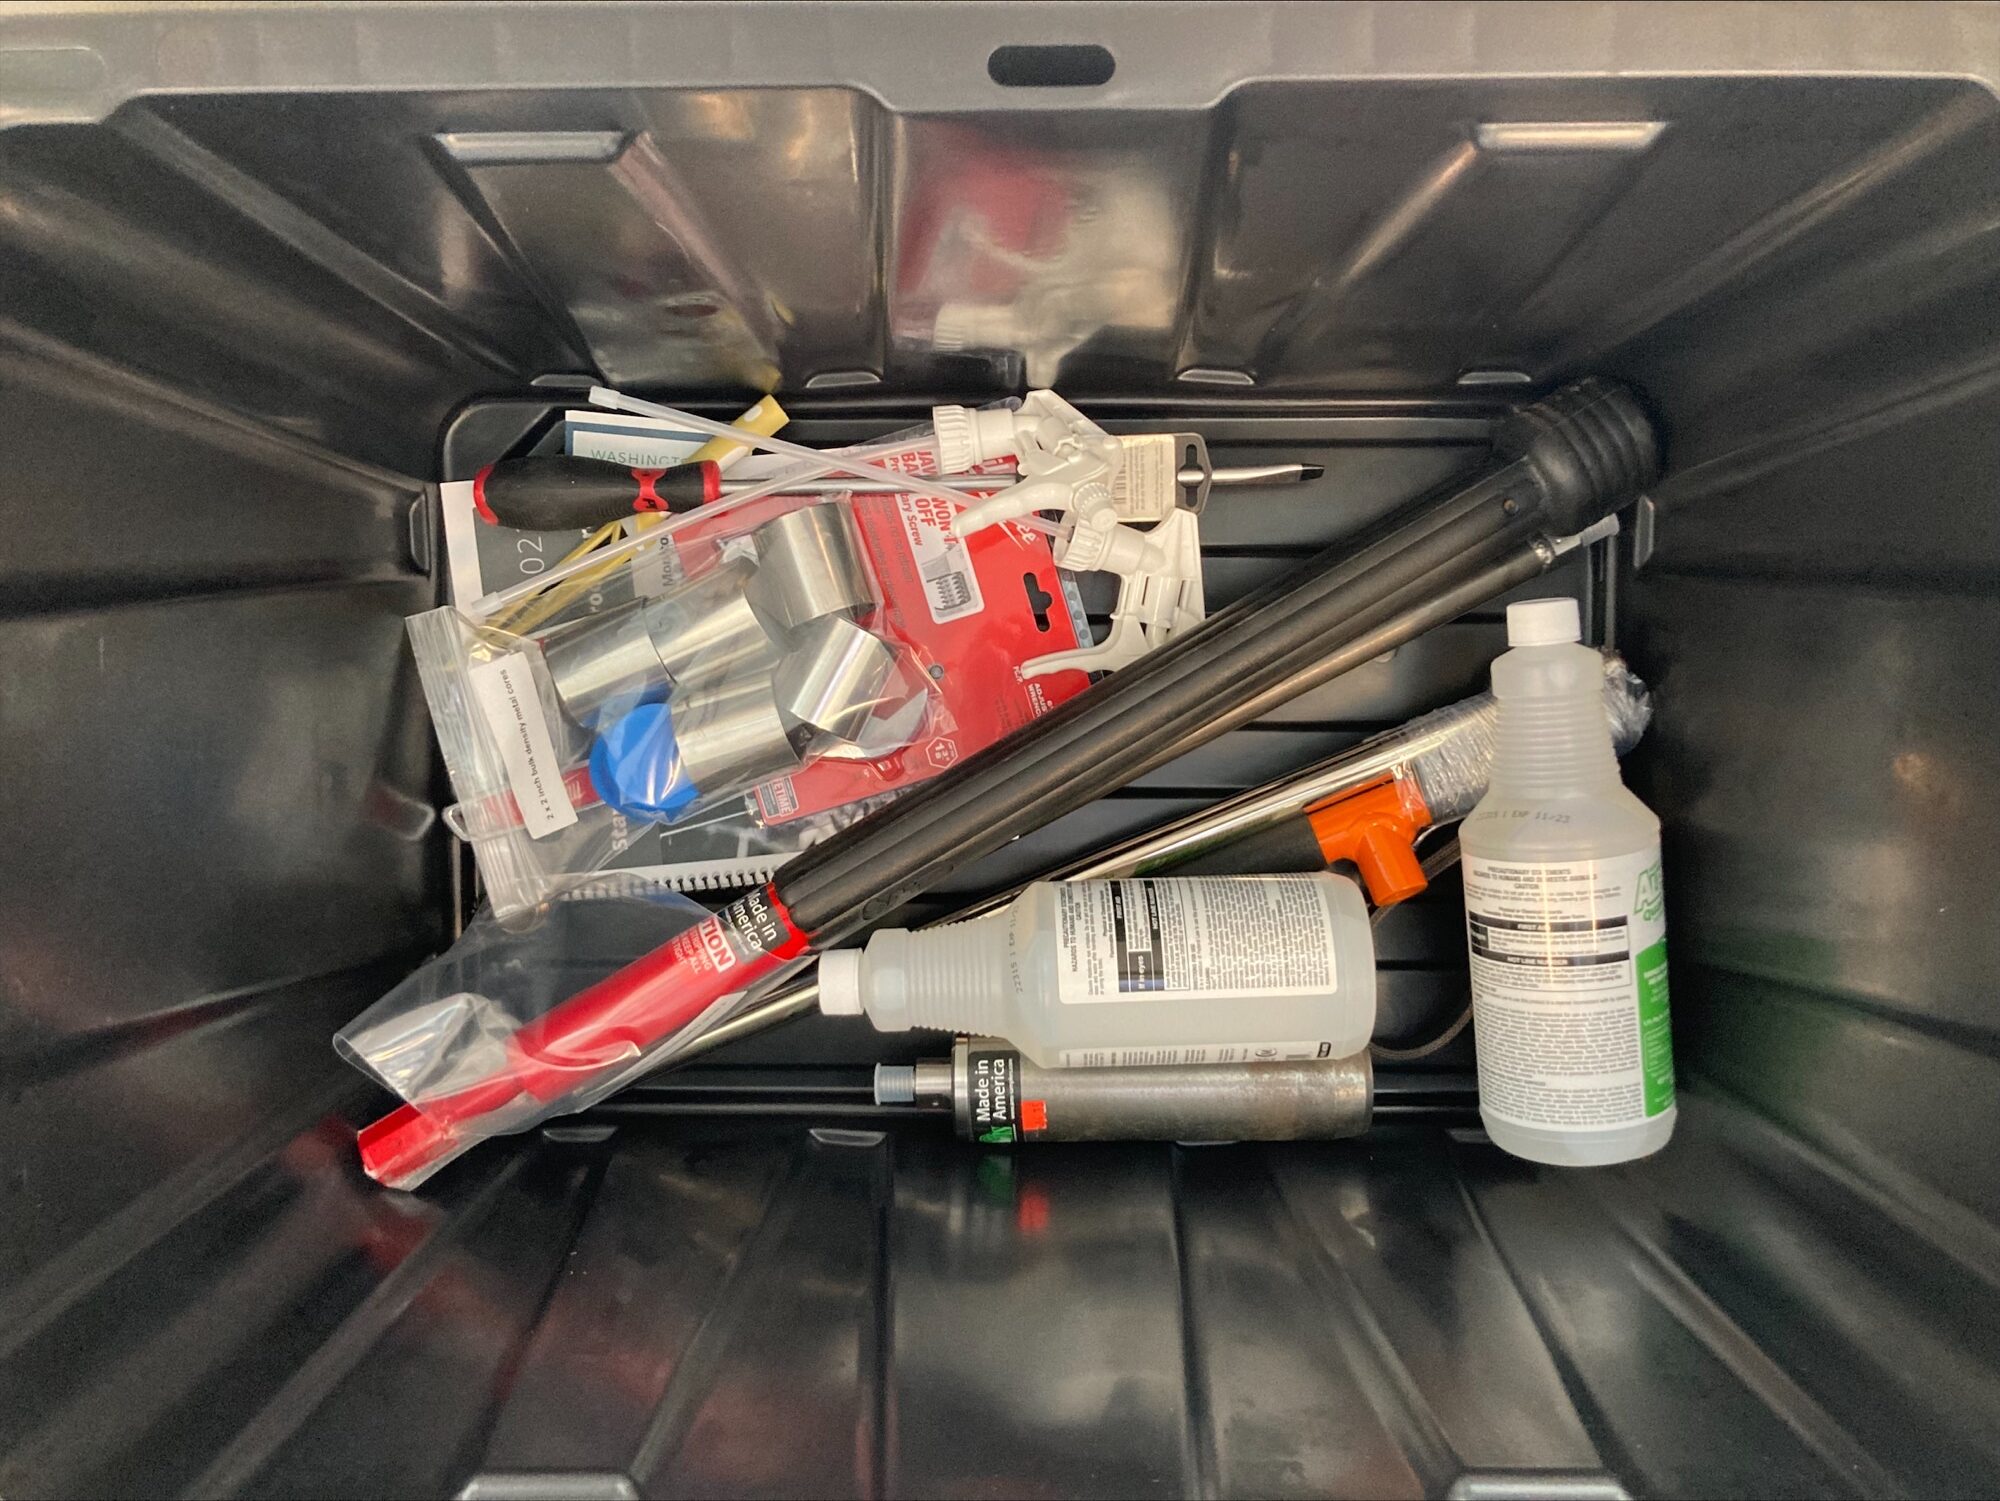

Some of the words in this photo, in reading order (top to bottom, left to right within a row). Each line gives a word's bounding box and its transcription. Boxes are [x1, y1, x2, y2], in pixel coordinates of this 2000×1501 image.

[915, 498, 937, 527] OFF
[907, 514, 923, 547] Screw
[500, 668, 514, 694] cores
[508, 697, 523, 721] metal
[1034, 683, 1048, 712] ADJUS
[518, 722, 533, 754] density
[527, 757, 539, 777] bulk
[533, 777, 546, 797] inch
[541, 798, 549, 807] 2
[703, 918, 732, 968] TION
[762, 922, 777, 941] in
[689, 956, 701, 975] ALL
[1138, 955, 1146, 974] eyes
[975, 1059, 989, 1074] in
[975, 1078, 991, 1121] Made
[991, 1059, 1007, 1120] America
